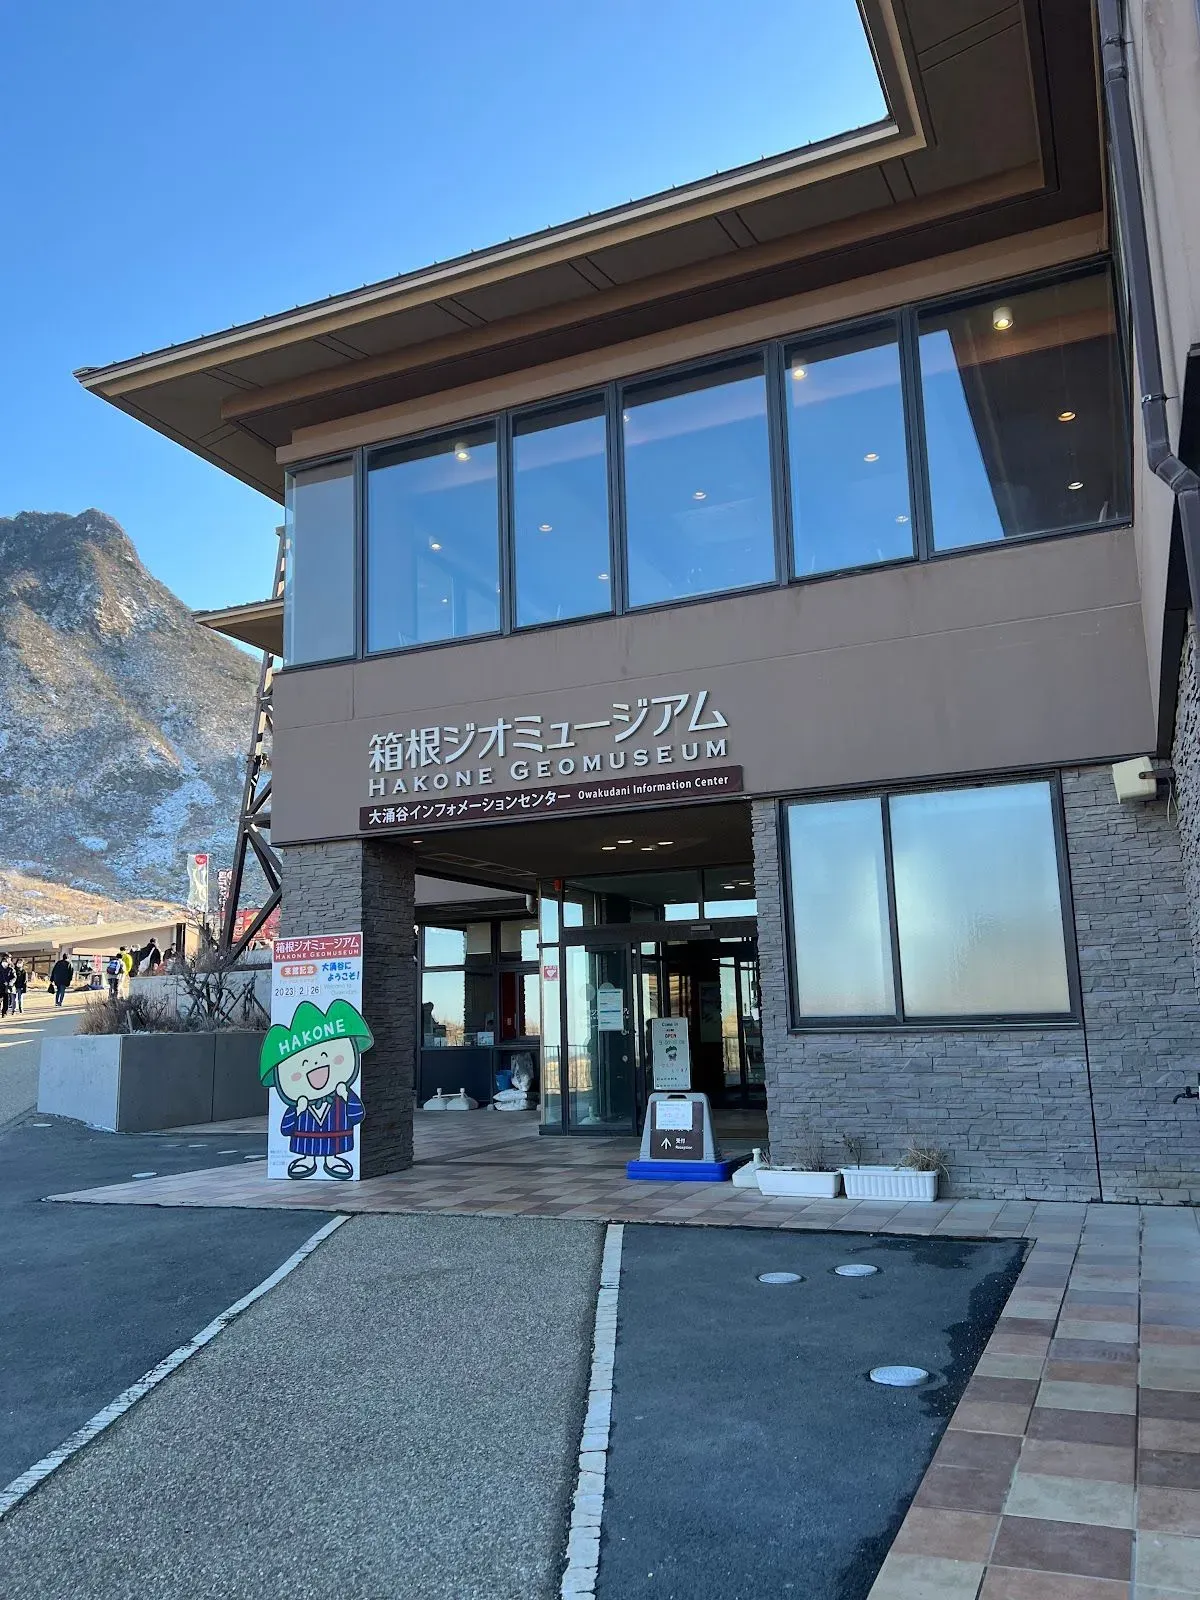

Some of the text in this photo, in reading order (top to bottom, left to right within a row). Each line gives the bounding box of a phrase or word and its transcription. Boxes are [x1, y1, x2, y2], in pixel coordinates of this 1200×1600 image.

[368, 690, 729, 773] 箱根ジオミュージアム
[368, 738, 728, 797] HAKONE GEOMUSEUM
[578, 776, 729, 800] Owakudani Information Center
[368, 792, 572, 825] 大涌谷インフォメーションセンター
[275, 937, 360, 954] 箱根ジオミュージアム
[310, 949, 359, 958] GEOMUSEUM
[321, 961, 352, 972] 大涌谷に
[275, 986, 320, 997] 2023 2 26
[278, 1018, 346, 1055] HAKONE
